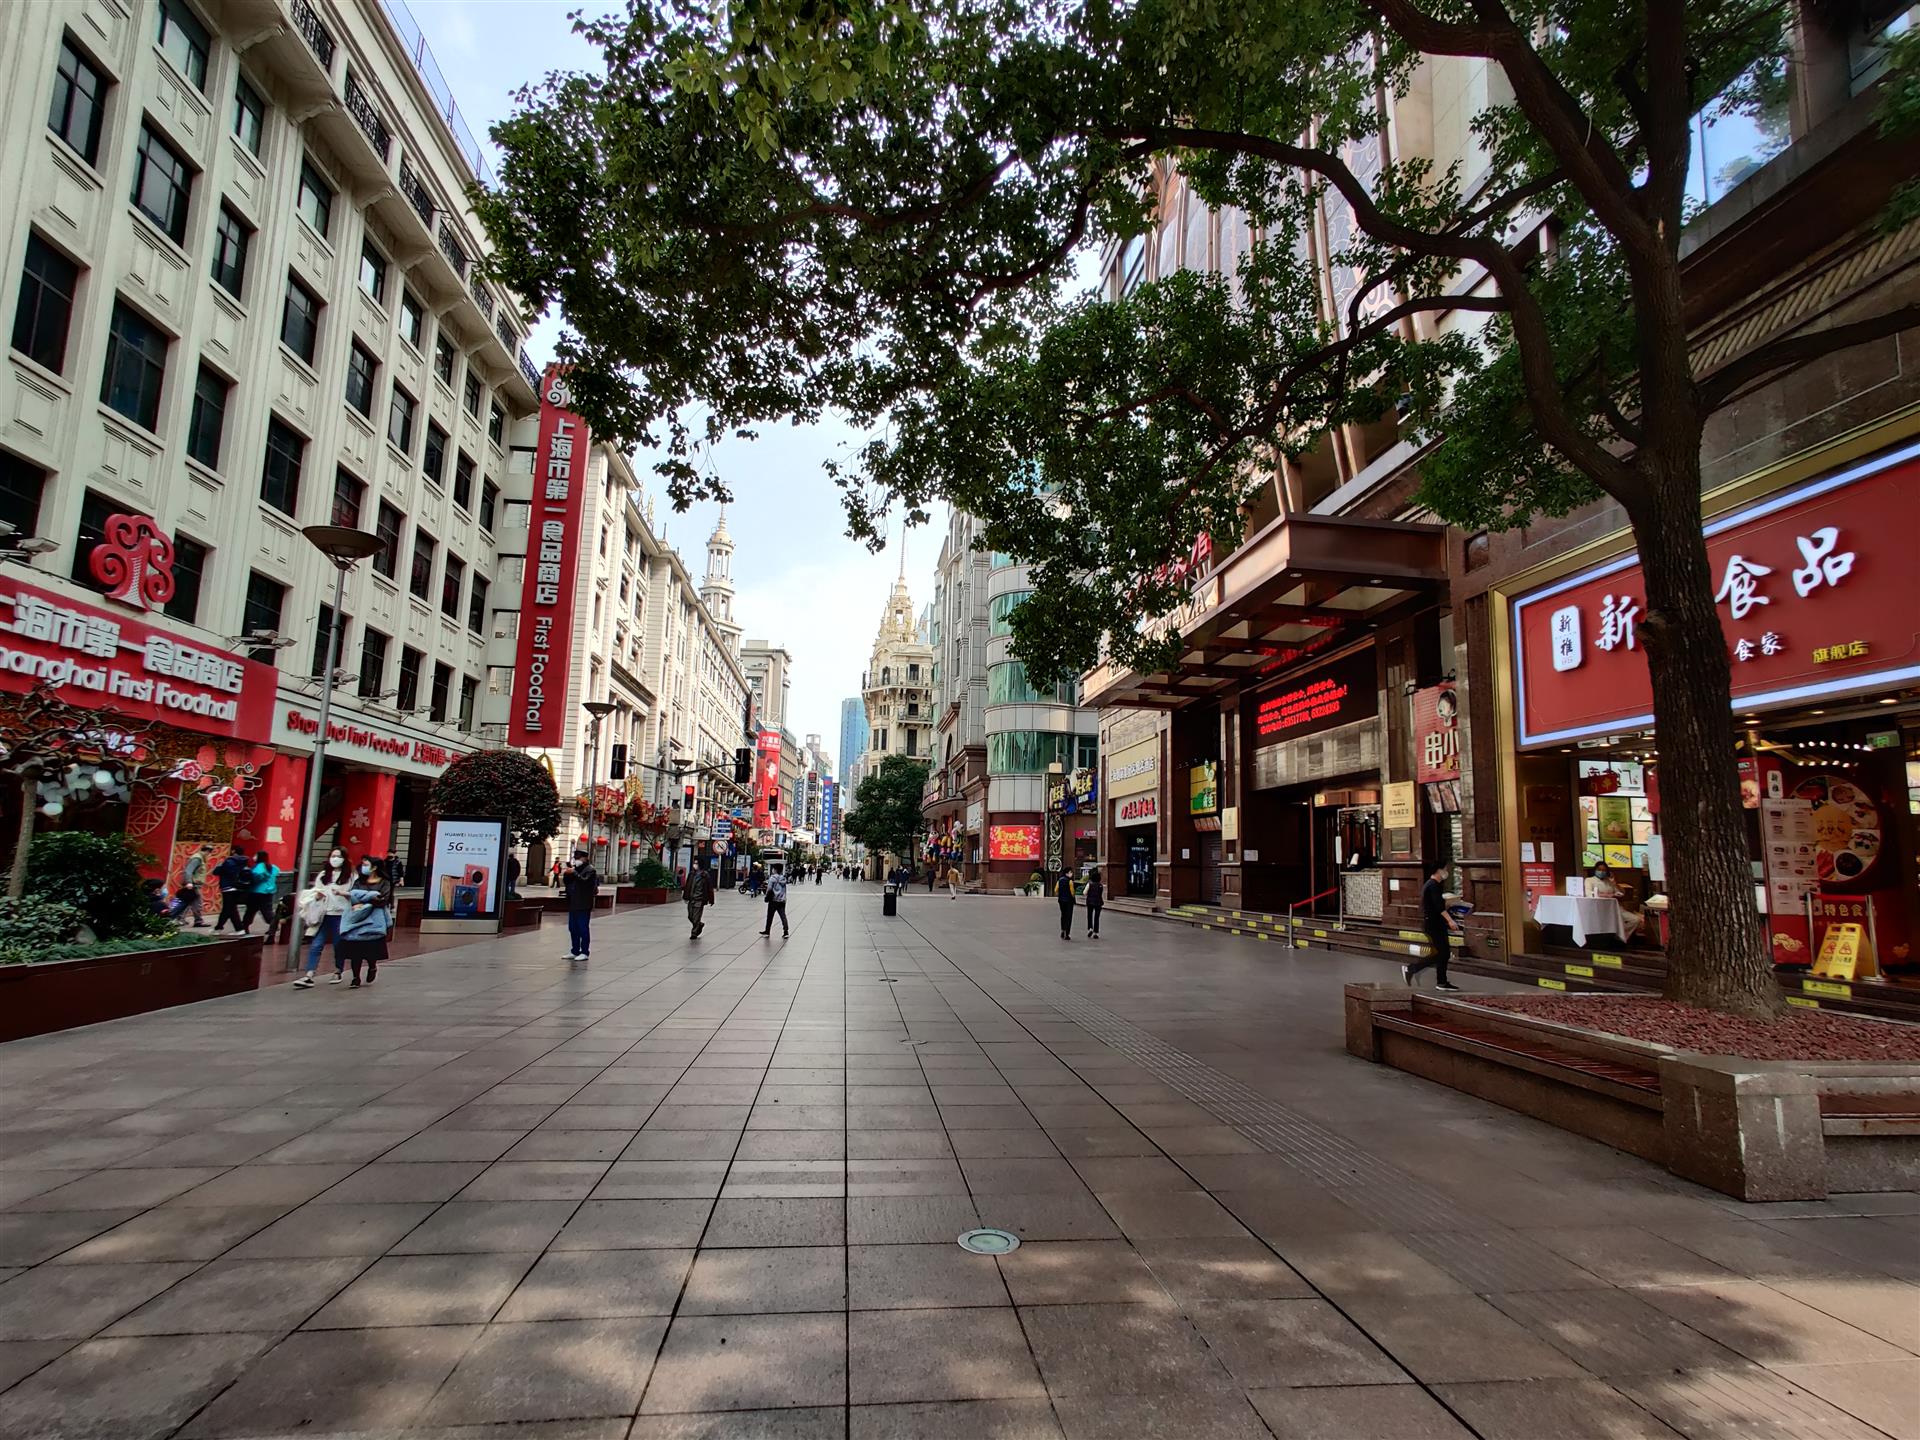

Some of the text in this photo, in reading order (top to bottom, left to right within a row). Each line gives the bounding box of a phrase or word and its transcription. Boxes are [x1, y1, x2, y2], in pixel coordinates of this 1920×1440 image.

[534, 418, 575, 605] 上海市第一食品商店
[1811, 640, 1870, 665] 旗舰店
[108, 668, 154, 702] First
[154, 681, 238, 721] Foodhall
[525, 616, 552, 732] First Foodhall
[347, 726, 369, 748] First
[369, 731, 410, 757] Foodhall
[447, 841, 464, 852] 5G
